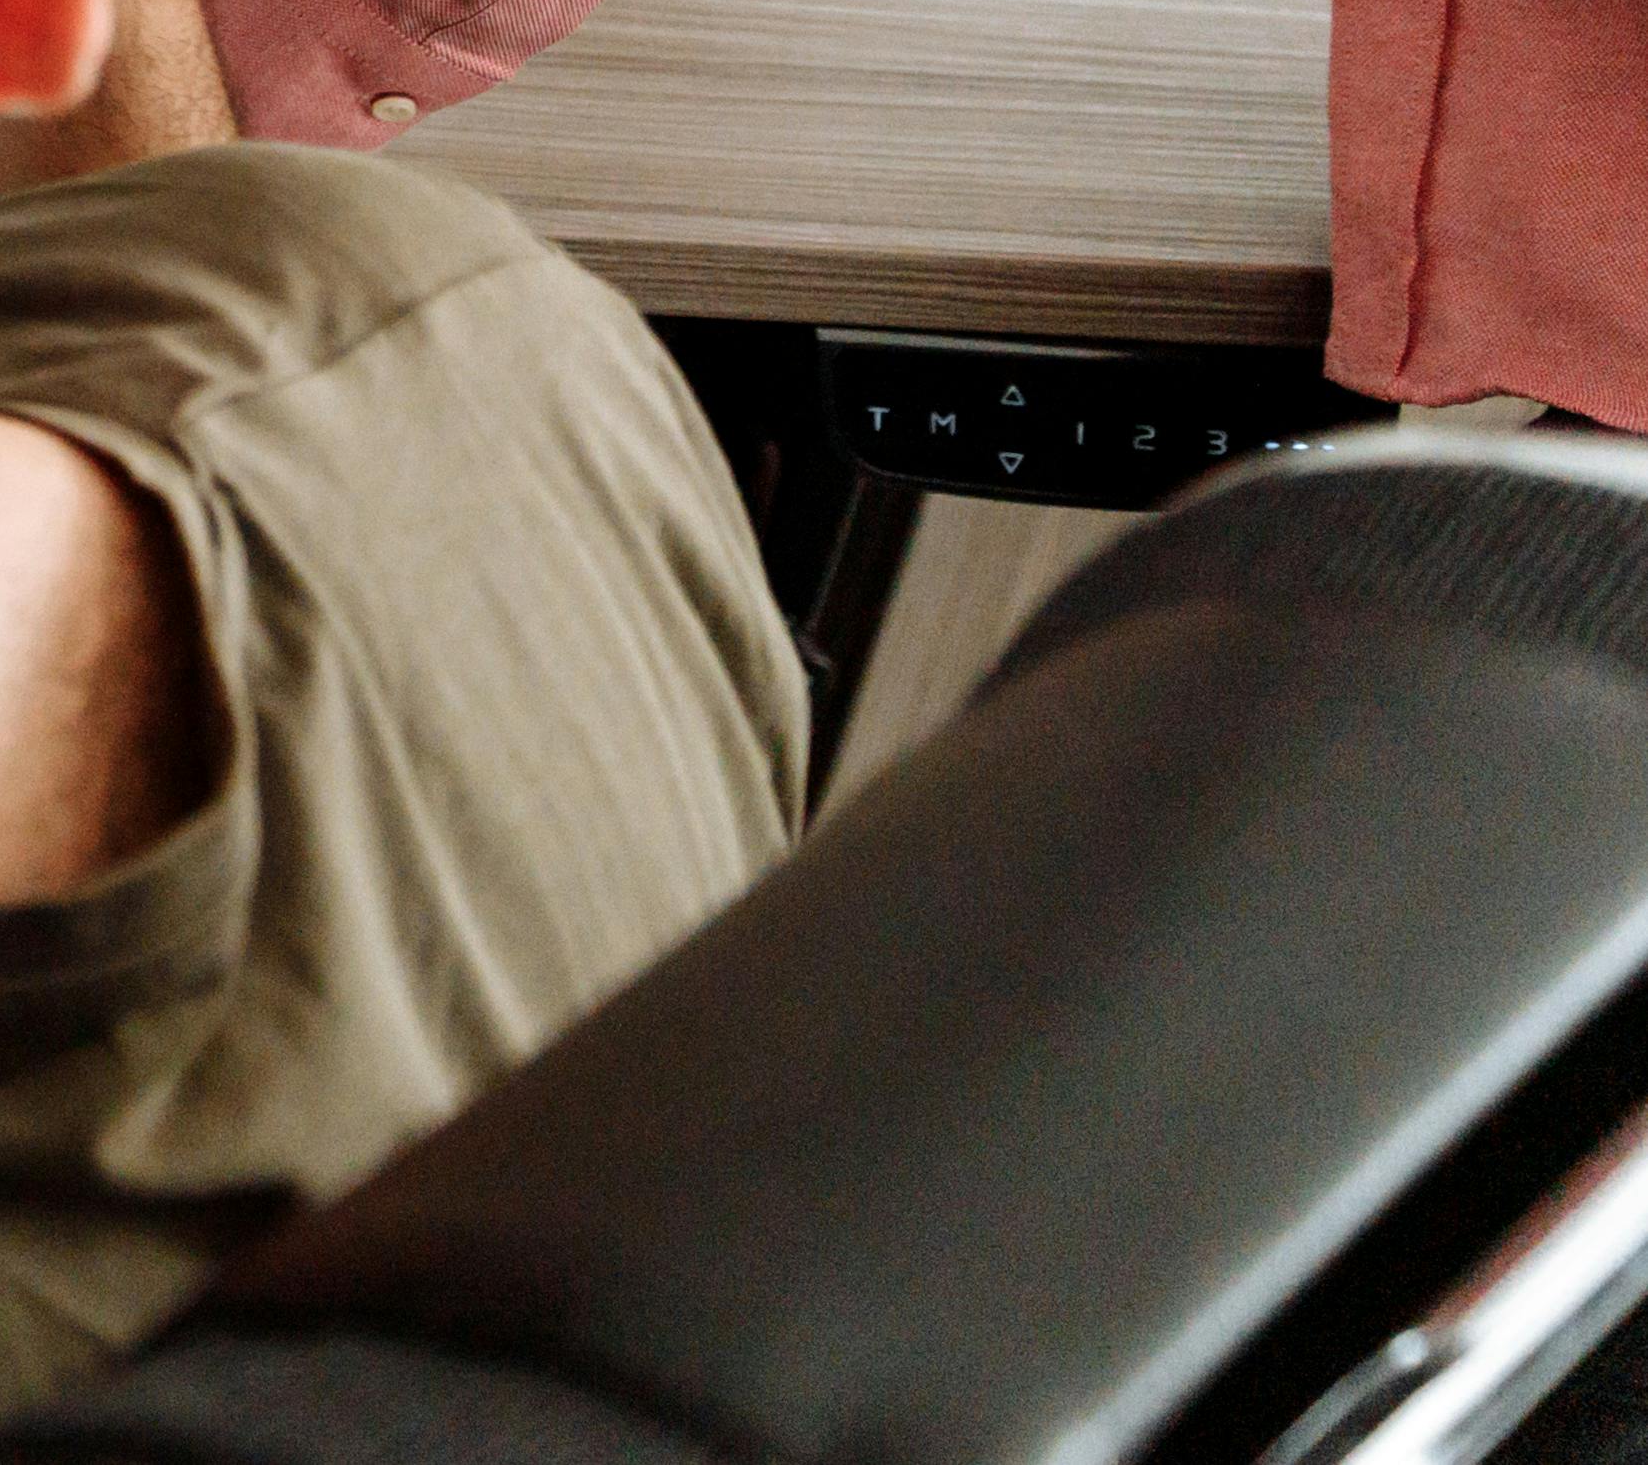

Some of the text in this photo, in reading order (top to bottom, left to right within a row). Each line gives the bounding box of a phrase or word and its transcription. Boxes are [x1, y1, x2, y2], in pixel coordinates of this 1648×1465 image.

[867, 406, 1228, 455] T M 1 2 3
